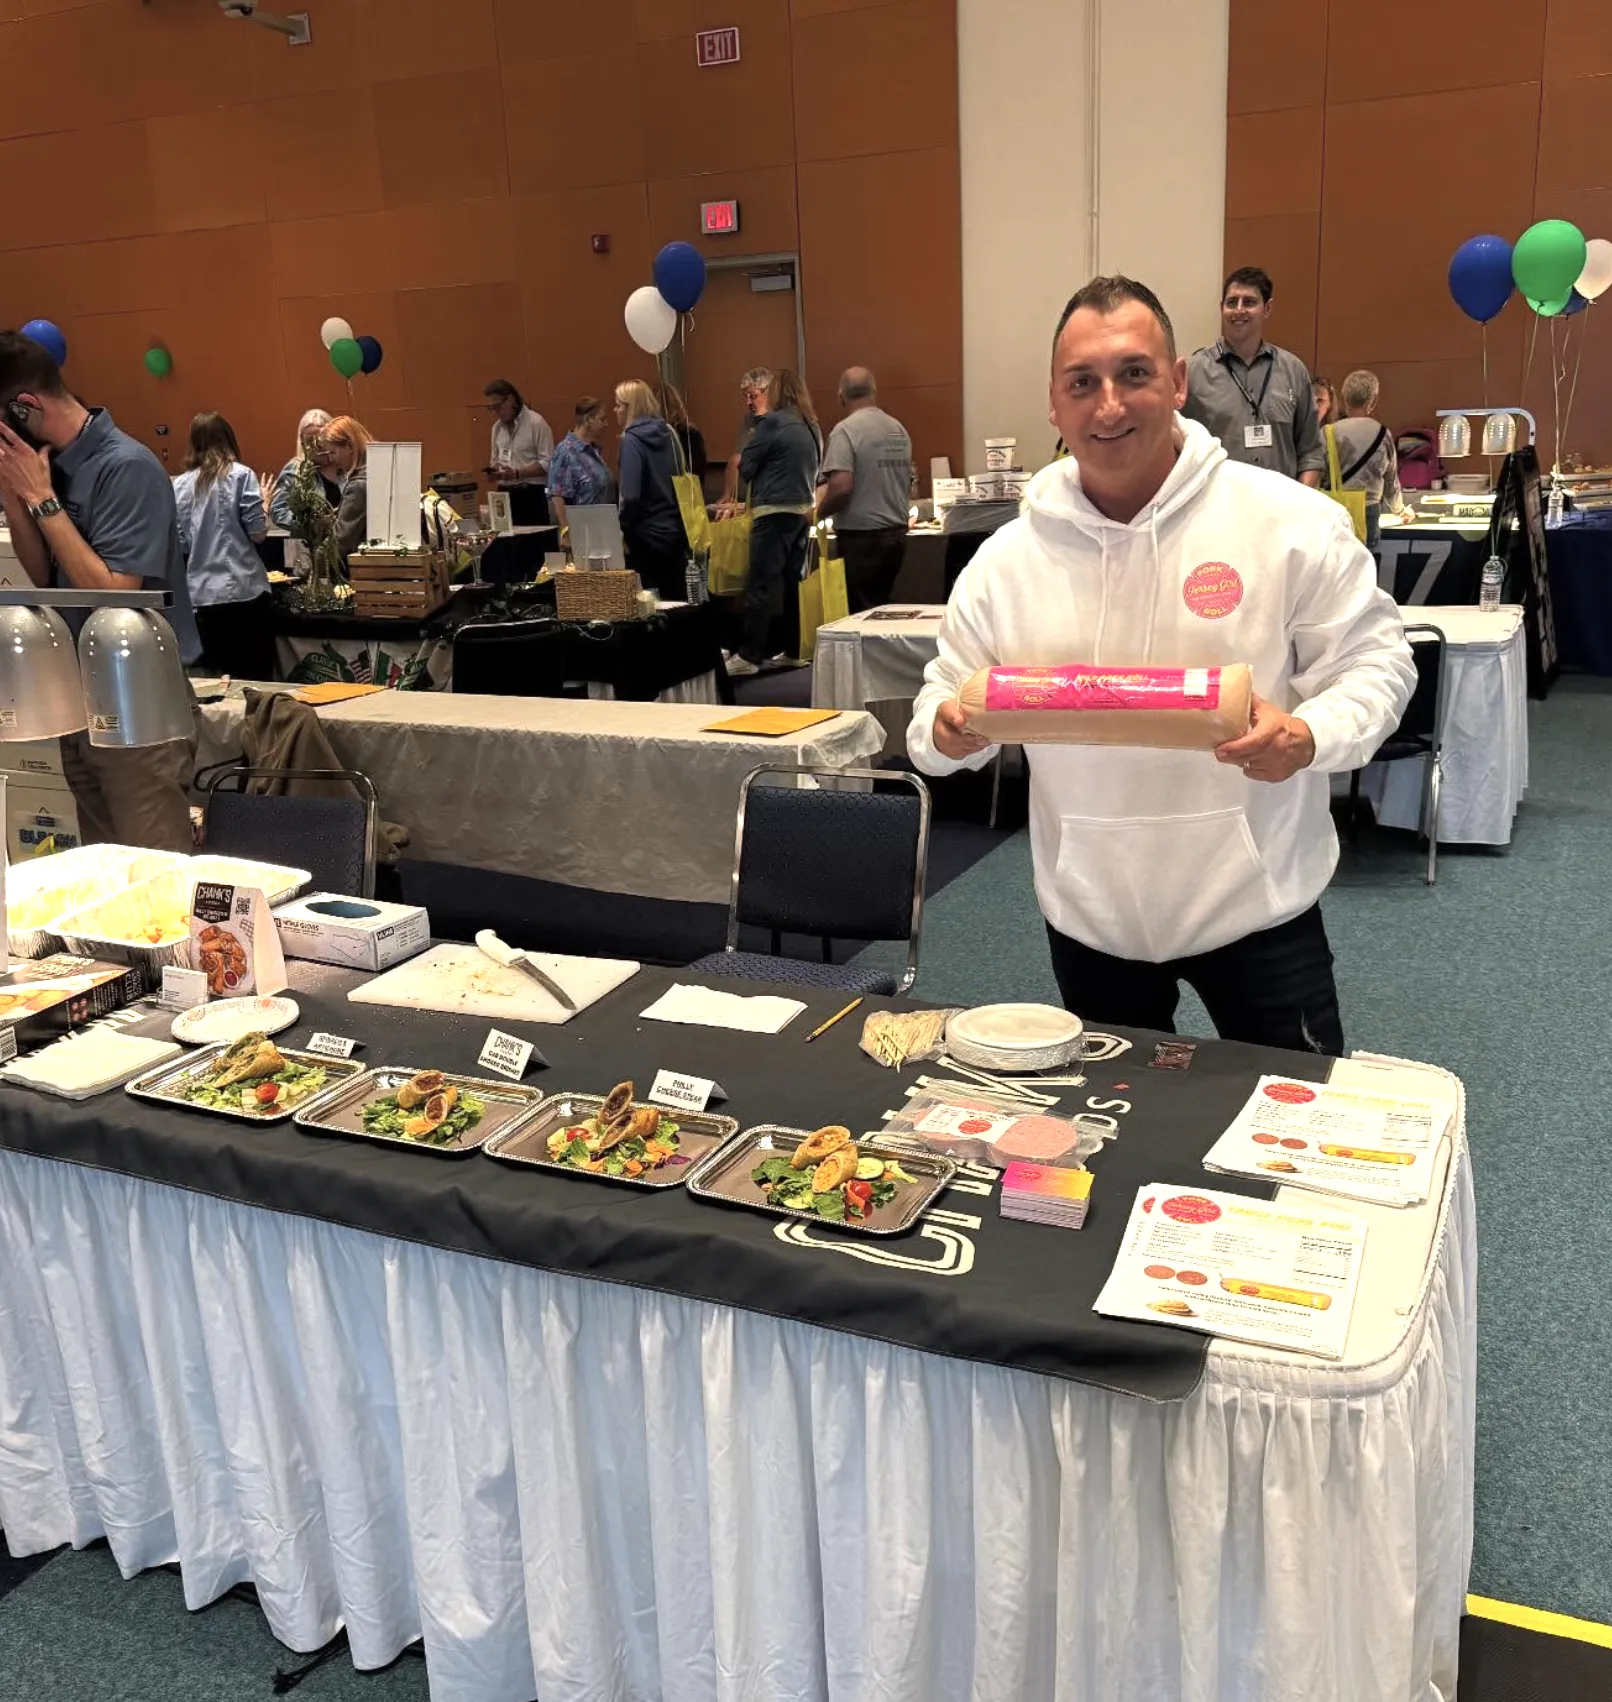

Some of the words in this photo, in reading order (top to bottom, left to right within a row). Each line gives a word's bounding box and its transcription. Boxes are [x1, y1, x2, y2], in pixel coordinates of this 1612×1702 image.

[704, 33, 733, 61] EXIT
[707, 204, 734, 230] EXIT
[197, 886, 232, 903] CHANK'S
[125, 973, 133, 1001] CLUB
